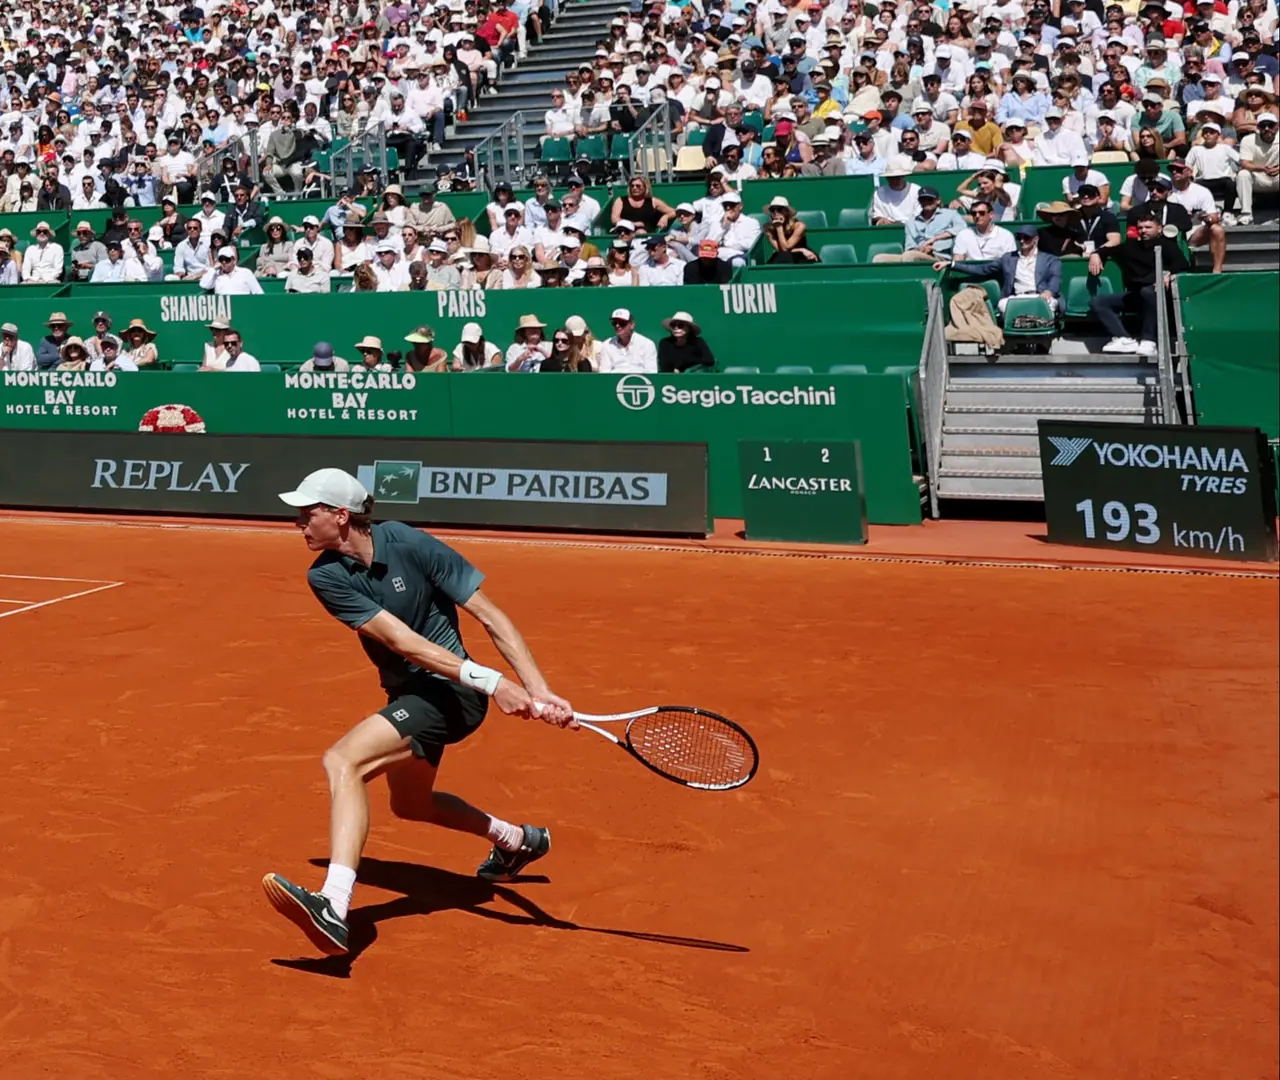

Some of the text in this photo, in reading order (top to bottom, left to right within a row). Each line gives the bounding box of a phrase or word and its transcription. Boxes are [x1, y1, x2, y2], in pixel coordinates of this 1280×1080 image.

[160, 296, 232, 322] SHANGHAI
[437, 290, 487, 318] PARIS
[720, 283, 777, 314] TURIN
[44, 390, 76, 405] BAY
[332, 392, 369, 409] BAY
[661, 385, 836, 408] Sergio Tacchini
[6, 404, 119, 416] HOTEL & RESORT
[287, 408, 418, 421] HOTEL & RESORT
[763, 446, 830, 463] 1 2
[1093, 442, 1250, 473] YOKOHAMA
[90, 458, 252, 494] REPLAY
[430, 471, 651, 501] BNP PARIBAS
[748, 473, 853, 492] LANCASTER
[1180, 474, 1248, 495] TYRES
[1075, 498, 1245, 554] 193 km/h
